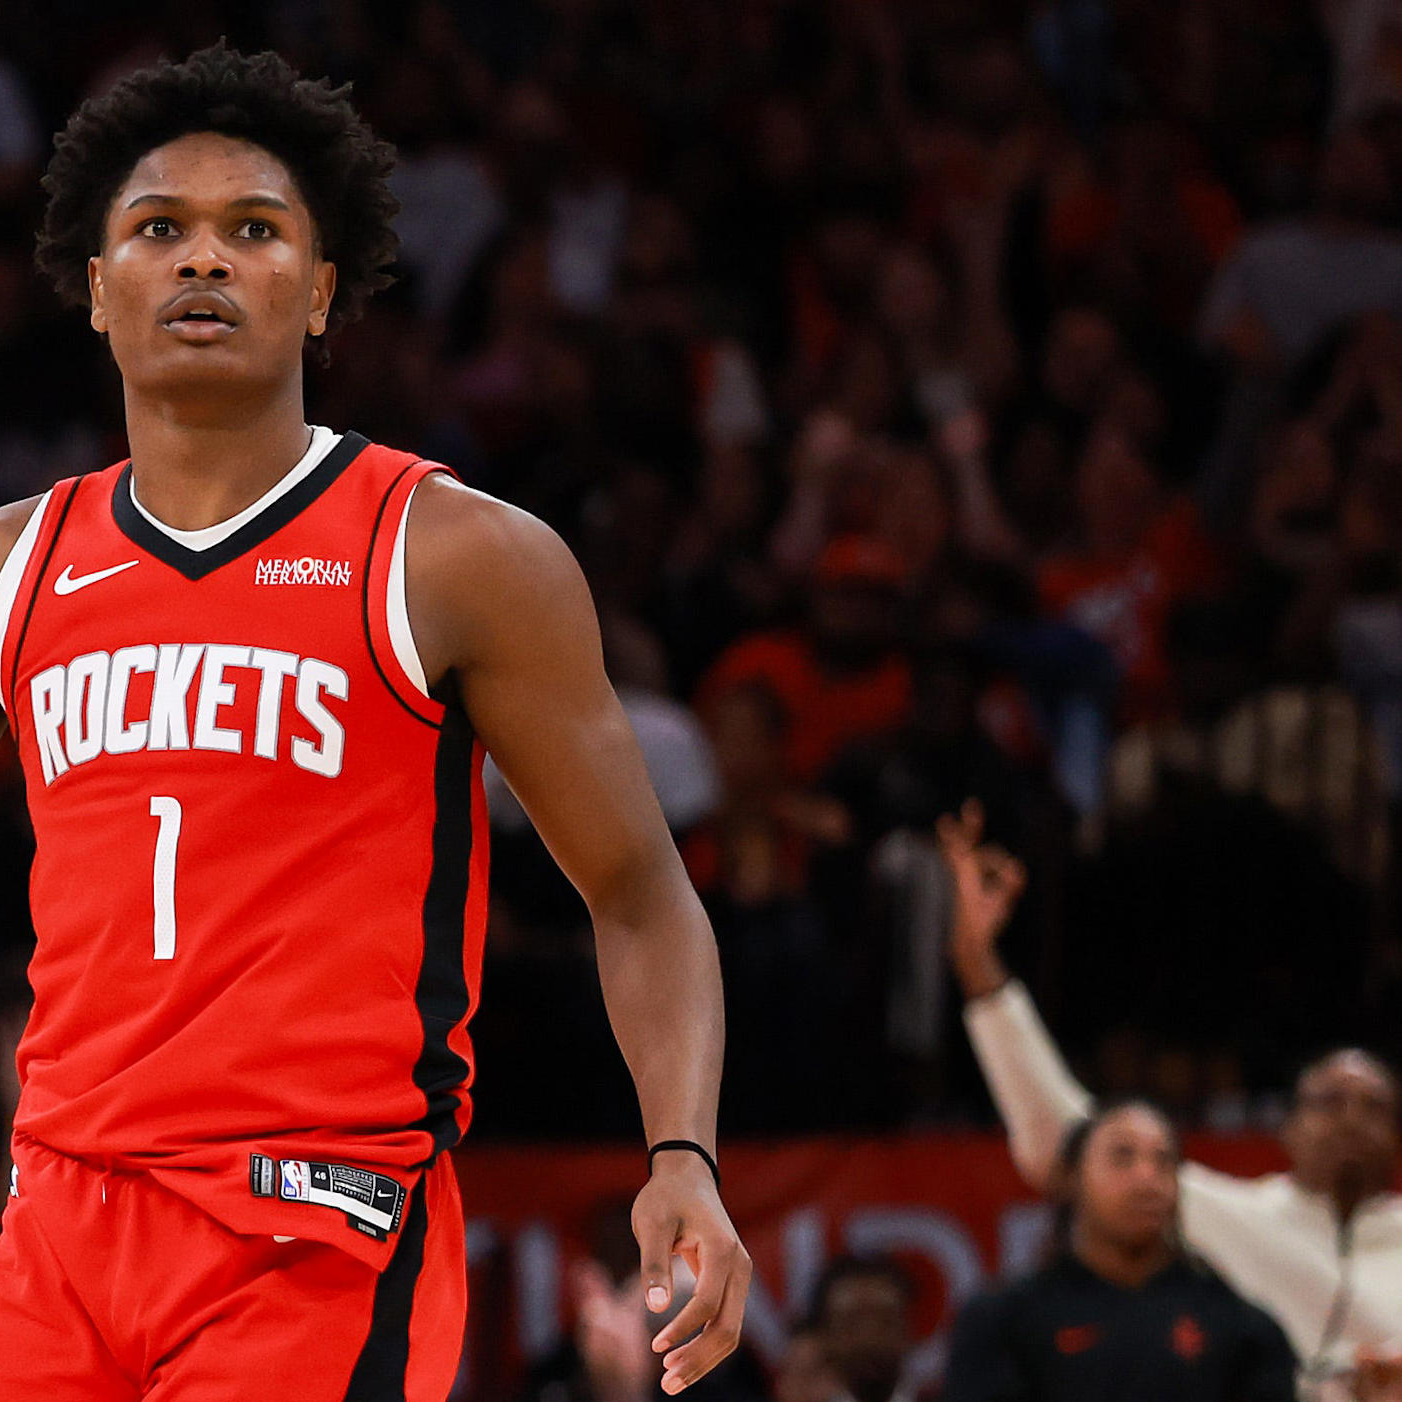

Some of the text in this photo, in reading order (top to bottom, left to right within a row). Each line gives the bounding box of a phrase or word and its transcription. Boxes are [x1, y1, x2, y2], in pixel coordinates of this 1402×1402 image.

[255, 571, 353, 586] HERMANN
[256, 556, 353, 575] MEMORIAL
[29, 643, 350, 788] ROCKETS
[150, 796, 182, 960] 1
